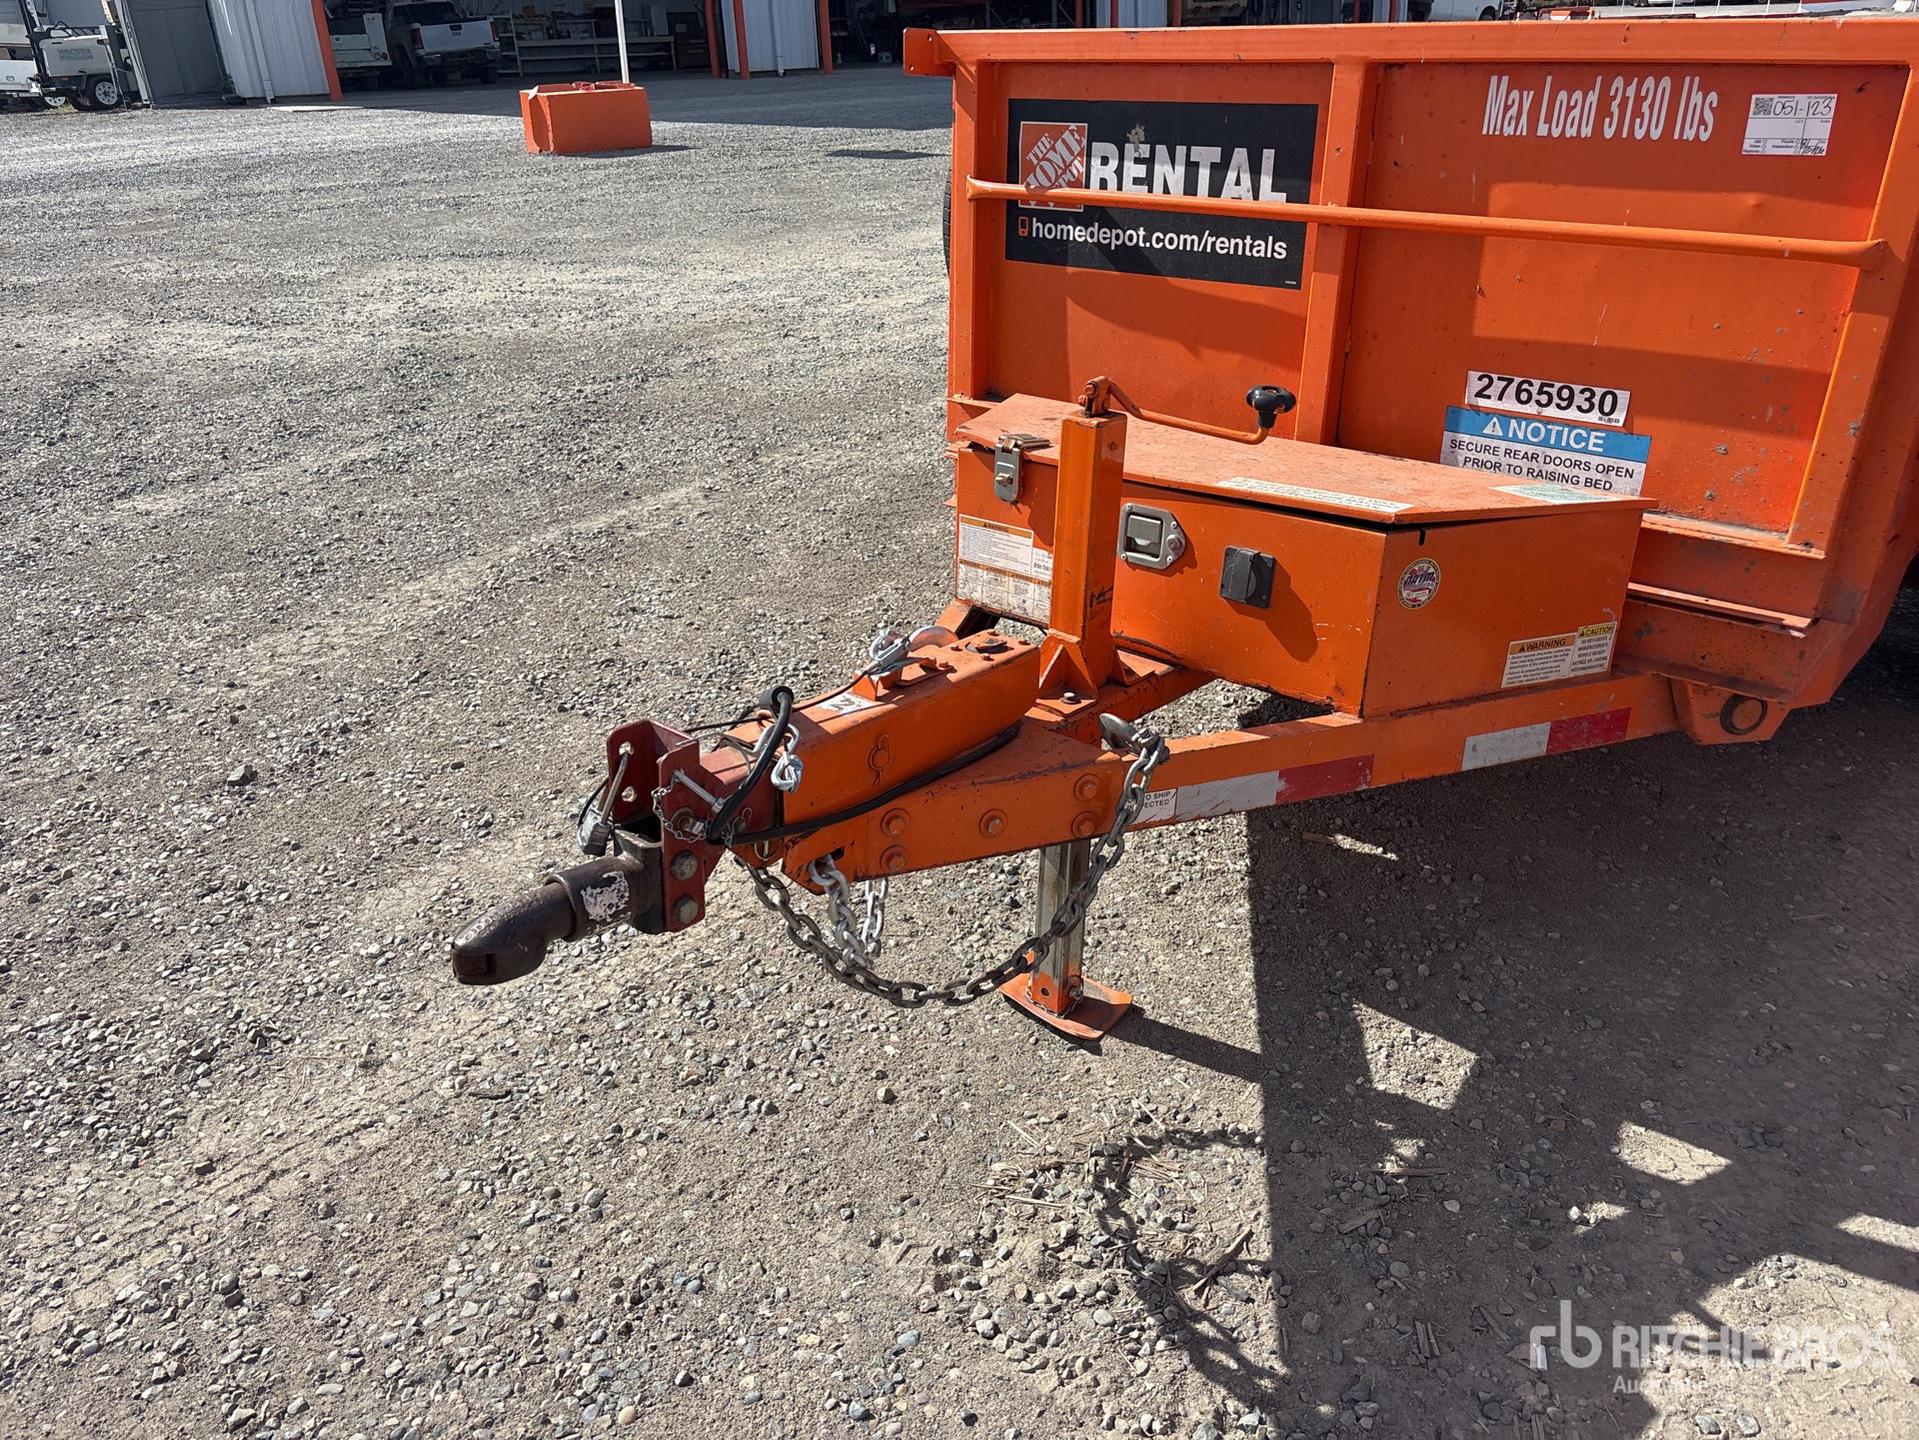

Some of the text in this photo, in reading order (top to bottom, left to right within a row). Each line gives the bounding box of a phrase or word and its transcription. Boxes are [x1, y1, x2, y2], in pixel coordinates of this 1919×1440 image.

[1482, 75, 1718, 142] Max Load 3130 lbs
[1773, 97, 1832, 117] 051-123
[1026, 132, 1054, 166] THE
[1089, 141, 1287, 204] RENTAL
[1032, 217, 1287, 260] homedepot.com/rentals
[1474, 373, 1618, 417] 2765930
[1508, 419, 1606, 452] NOTICE
[1450, 439, 1635, 479] SECURE REAR DOORS OPEN
[1463, 456, 1613, 491] PRIOR TO RAISING BED
[1526, 638, 1566, 651] WARNING
[1586, 625, 1615, 636] CAUTION
[1153, 790, 1171, 800] SHIP
